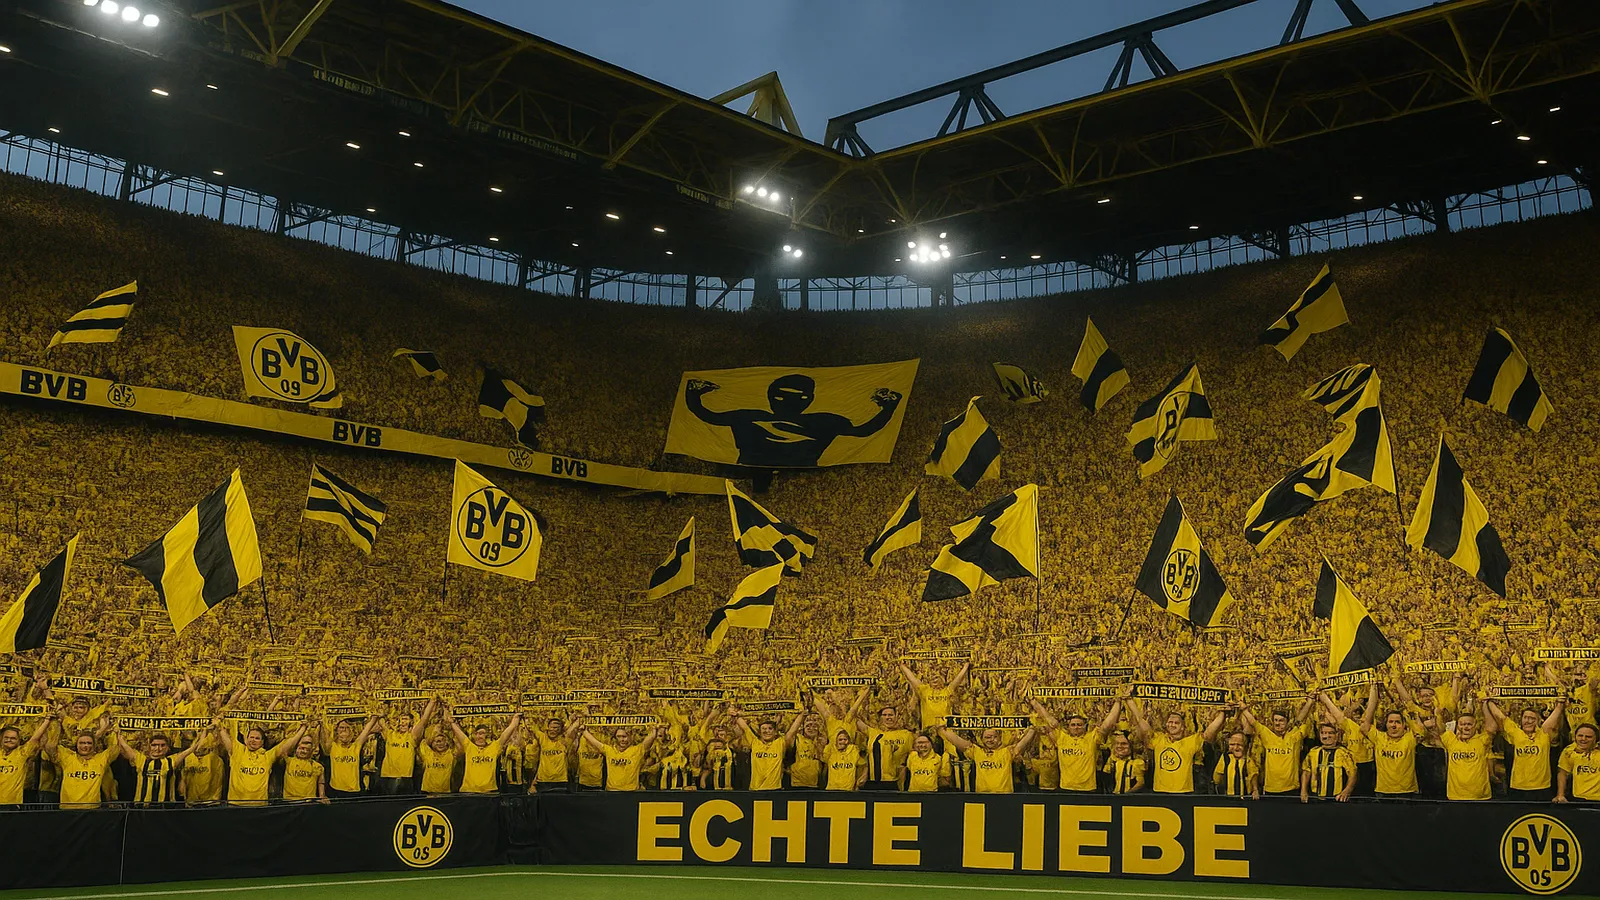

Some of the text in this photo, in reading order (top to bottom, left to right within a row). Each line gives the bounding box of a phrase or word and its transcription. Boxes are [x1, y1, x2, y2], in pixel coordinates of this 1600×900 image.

[262, 338, 320, 386] BVB
[20, 369, 87, 401] BVB
[280, 379, 302, 397] 09
[332, 421, 382, 447] BVB
[551, 456, 588, 478] BVB
[465, 488, 526, 549] BVB
[479, 540, 502, 562] 09
[402, 814, 446, 849] BVB
[636, 799, 1250, 879] ECHTE LIEBE
[1511, 824, 1572, 872] BVB
